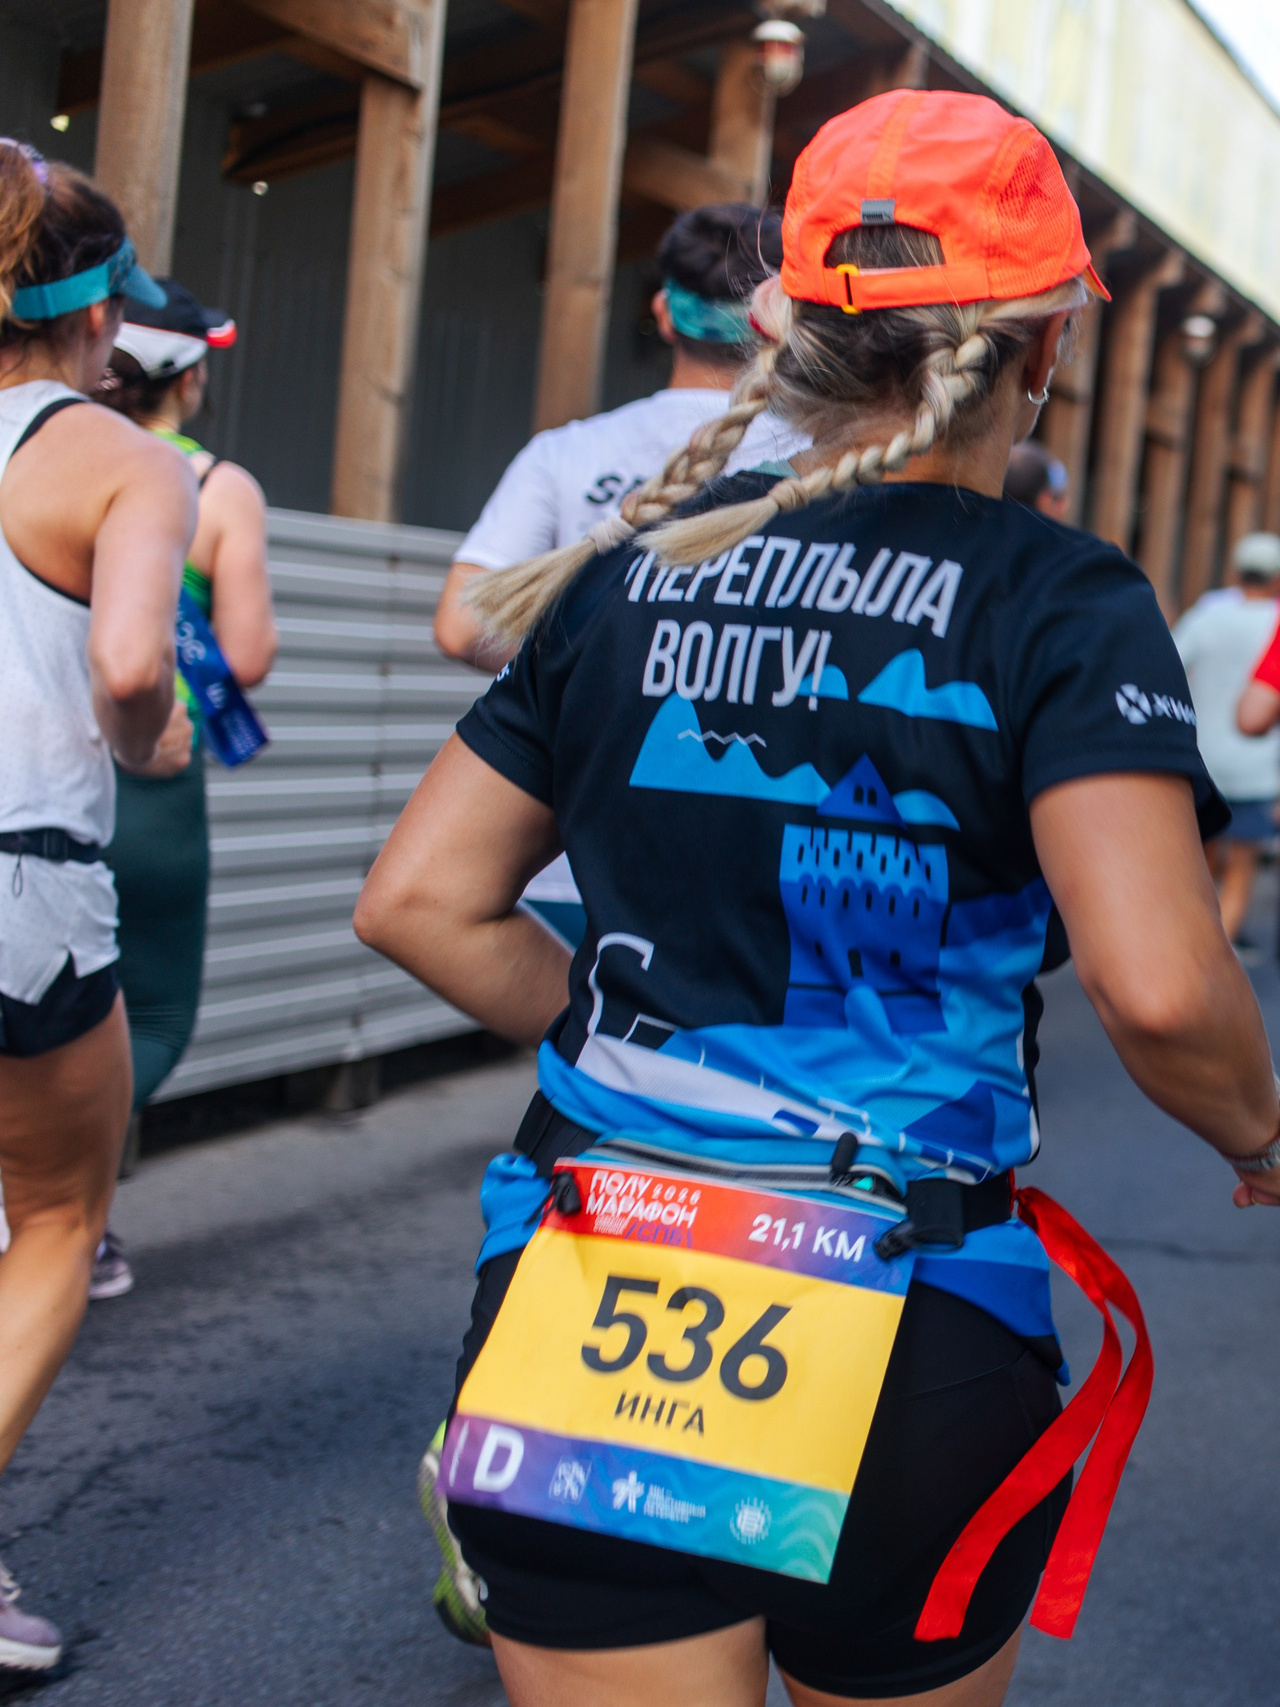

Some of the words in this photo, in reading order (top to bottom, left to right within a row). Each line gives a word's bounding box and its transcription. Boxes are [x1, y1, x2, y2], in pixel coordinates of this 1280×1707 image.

[641, 618, 833, 712] ВОЛГУ!
[590, 1169, 653, 1199] ПОЛУ
[586, 1192, 698, 1229] МАРАФОН
[749, 1213, 806, 1251] 21,1
[812, 1225, 867, 1263] КМ
[580, 1274, 794, 1402] 536
[613, 1390, 706, 1436] ИНГА
[472, 1424, 526, 1494] D
